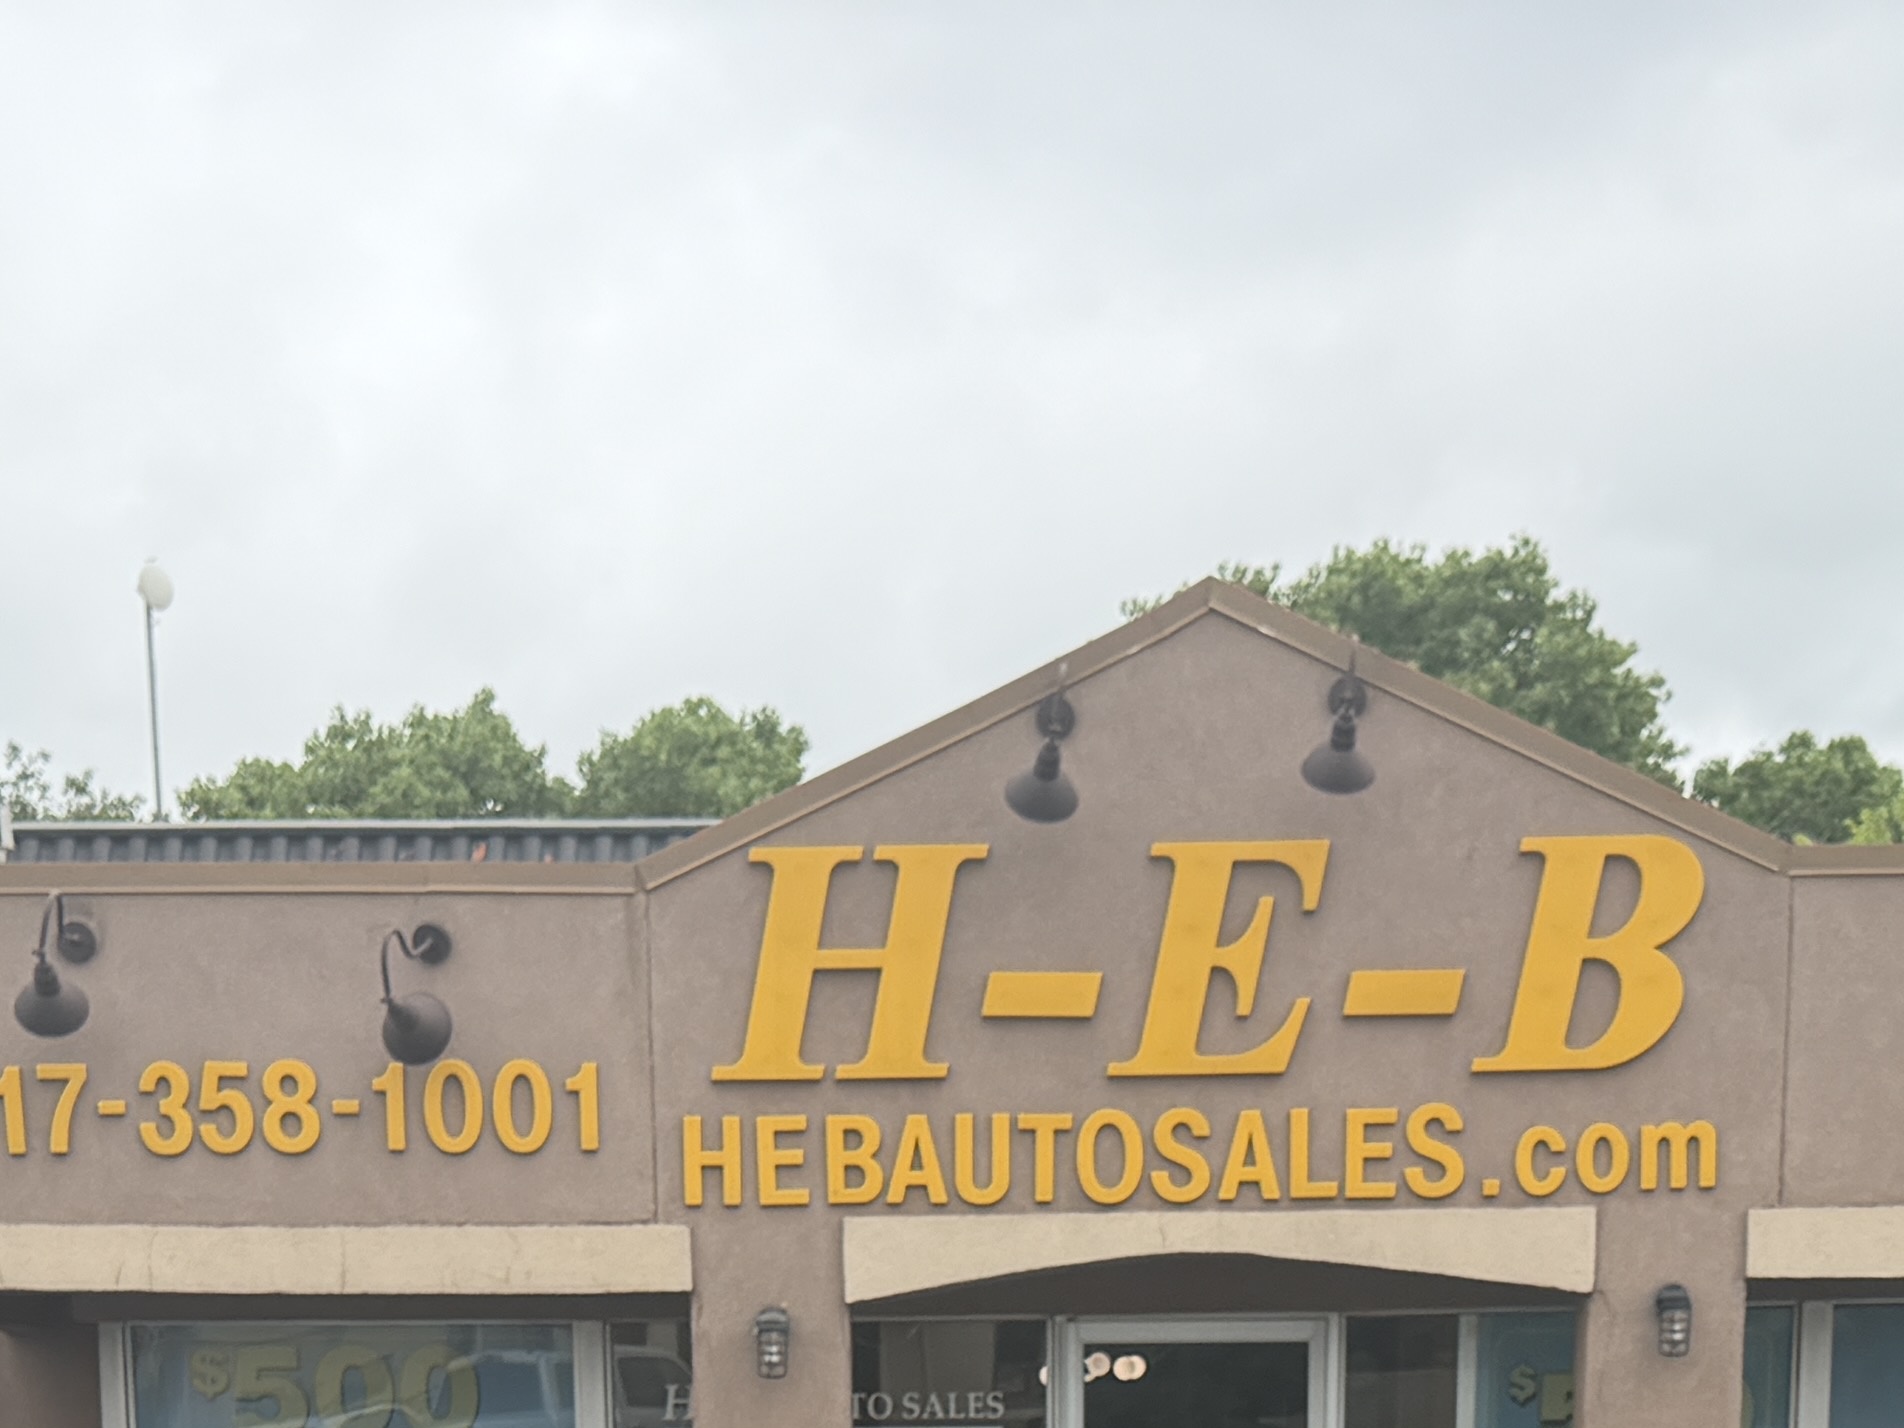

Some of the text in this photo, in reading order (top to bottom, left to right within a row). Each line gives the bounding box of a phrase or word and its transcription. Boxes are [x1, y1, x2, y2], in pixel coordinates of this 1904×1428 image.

[710, 834, 1704, 1082] H-E-B
[682, 1102, 1718, 1207] HEBAUTOSALES.com
[901, 1391, 1005, 1420] SALES
